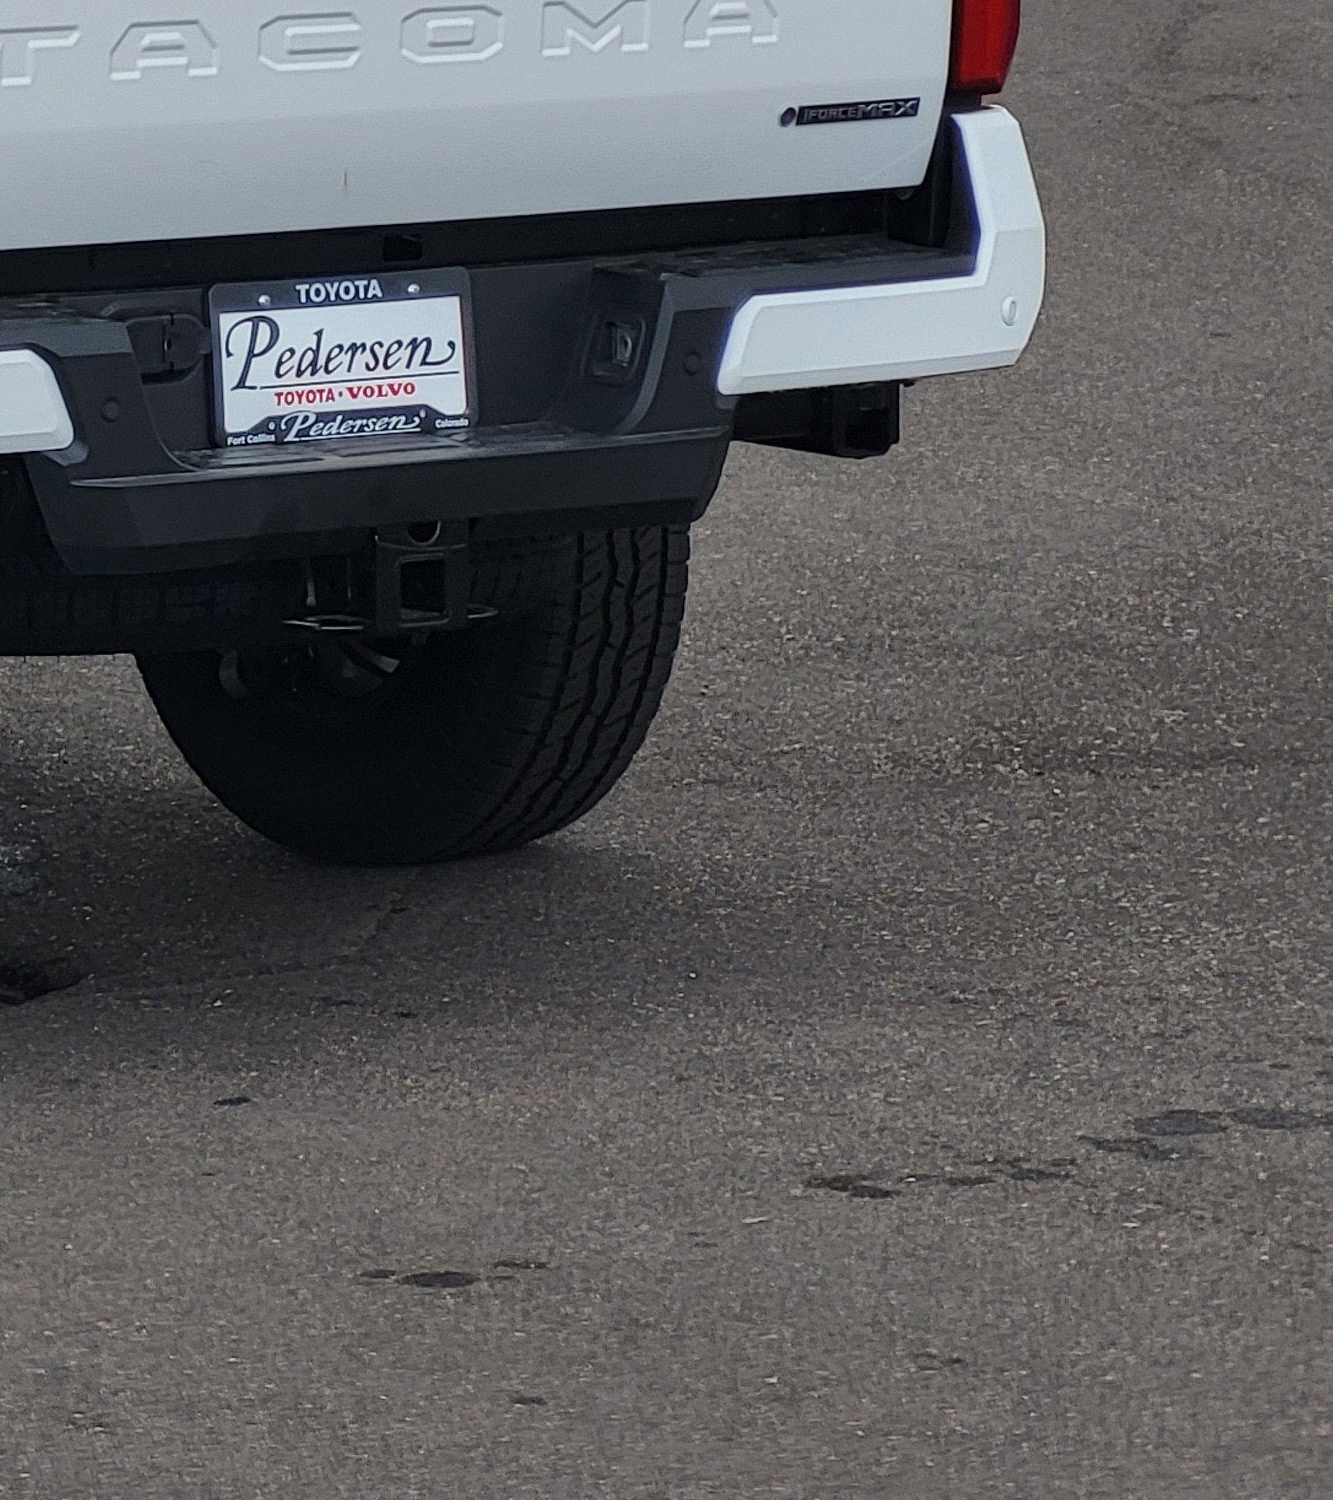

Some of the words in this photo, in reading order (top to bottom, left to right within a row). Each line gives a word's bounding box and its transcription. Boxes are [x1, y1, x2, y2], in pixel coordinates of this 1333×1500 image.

[295, 279, 383, 304] TOYOTA
[225, 314, 456, 391] Pedersen
[274, 387, 336, 406] TOYOTA
[346, 381, 416, 400] VOLVO
[280, 410, 421, 442] Pedersen
